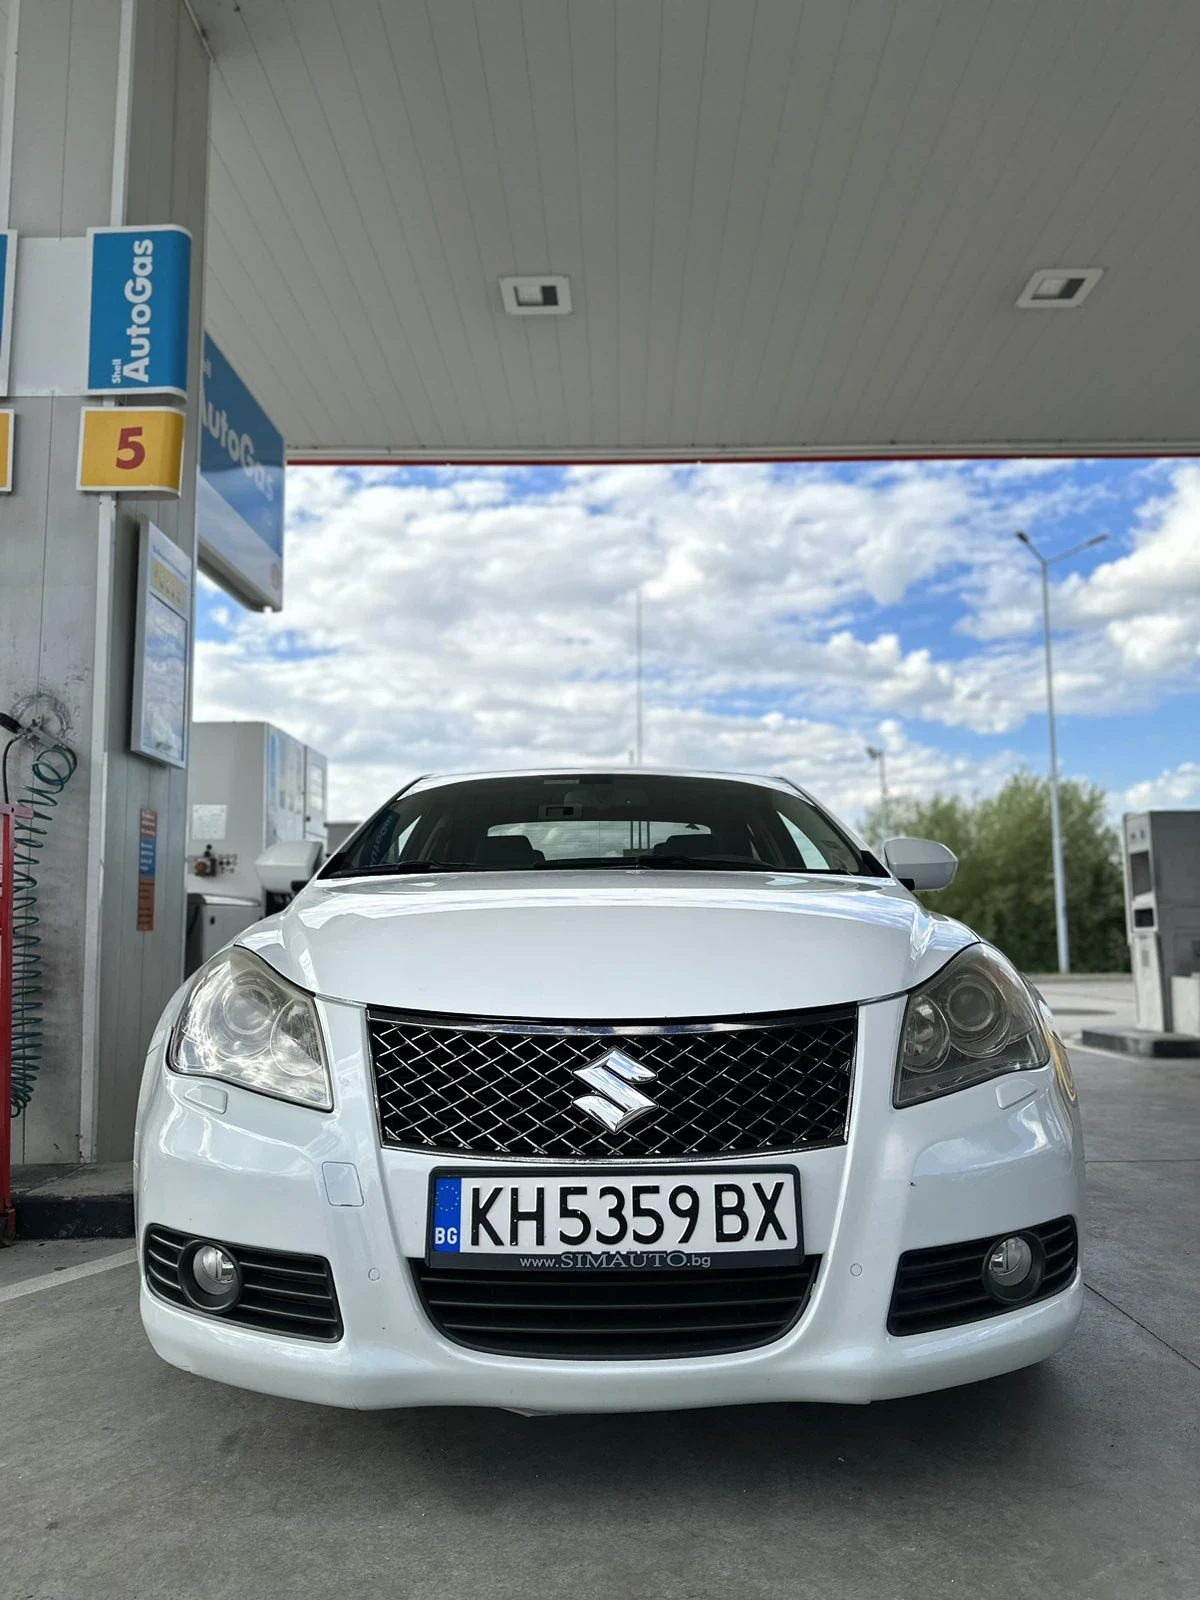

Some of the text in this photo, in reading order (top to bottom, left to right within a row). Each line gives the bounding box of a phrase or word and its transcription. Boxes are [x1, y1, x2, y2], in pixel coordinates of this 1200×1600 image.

[122, 239, 154, 383] AutoGas
[112, 358, 122, 384] Shell
[115, 426, 146, 470] 5
[434, 1227, 458, 1245] BG
[519, 1250, 712, 1270] www.SIMAUTO.bg
